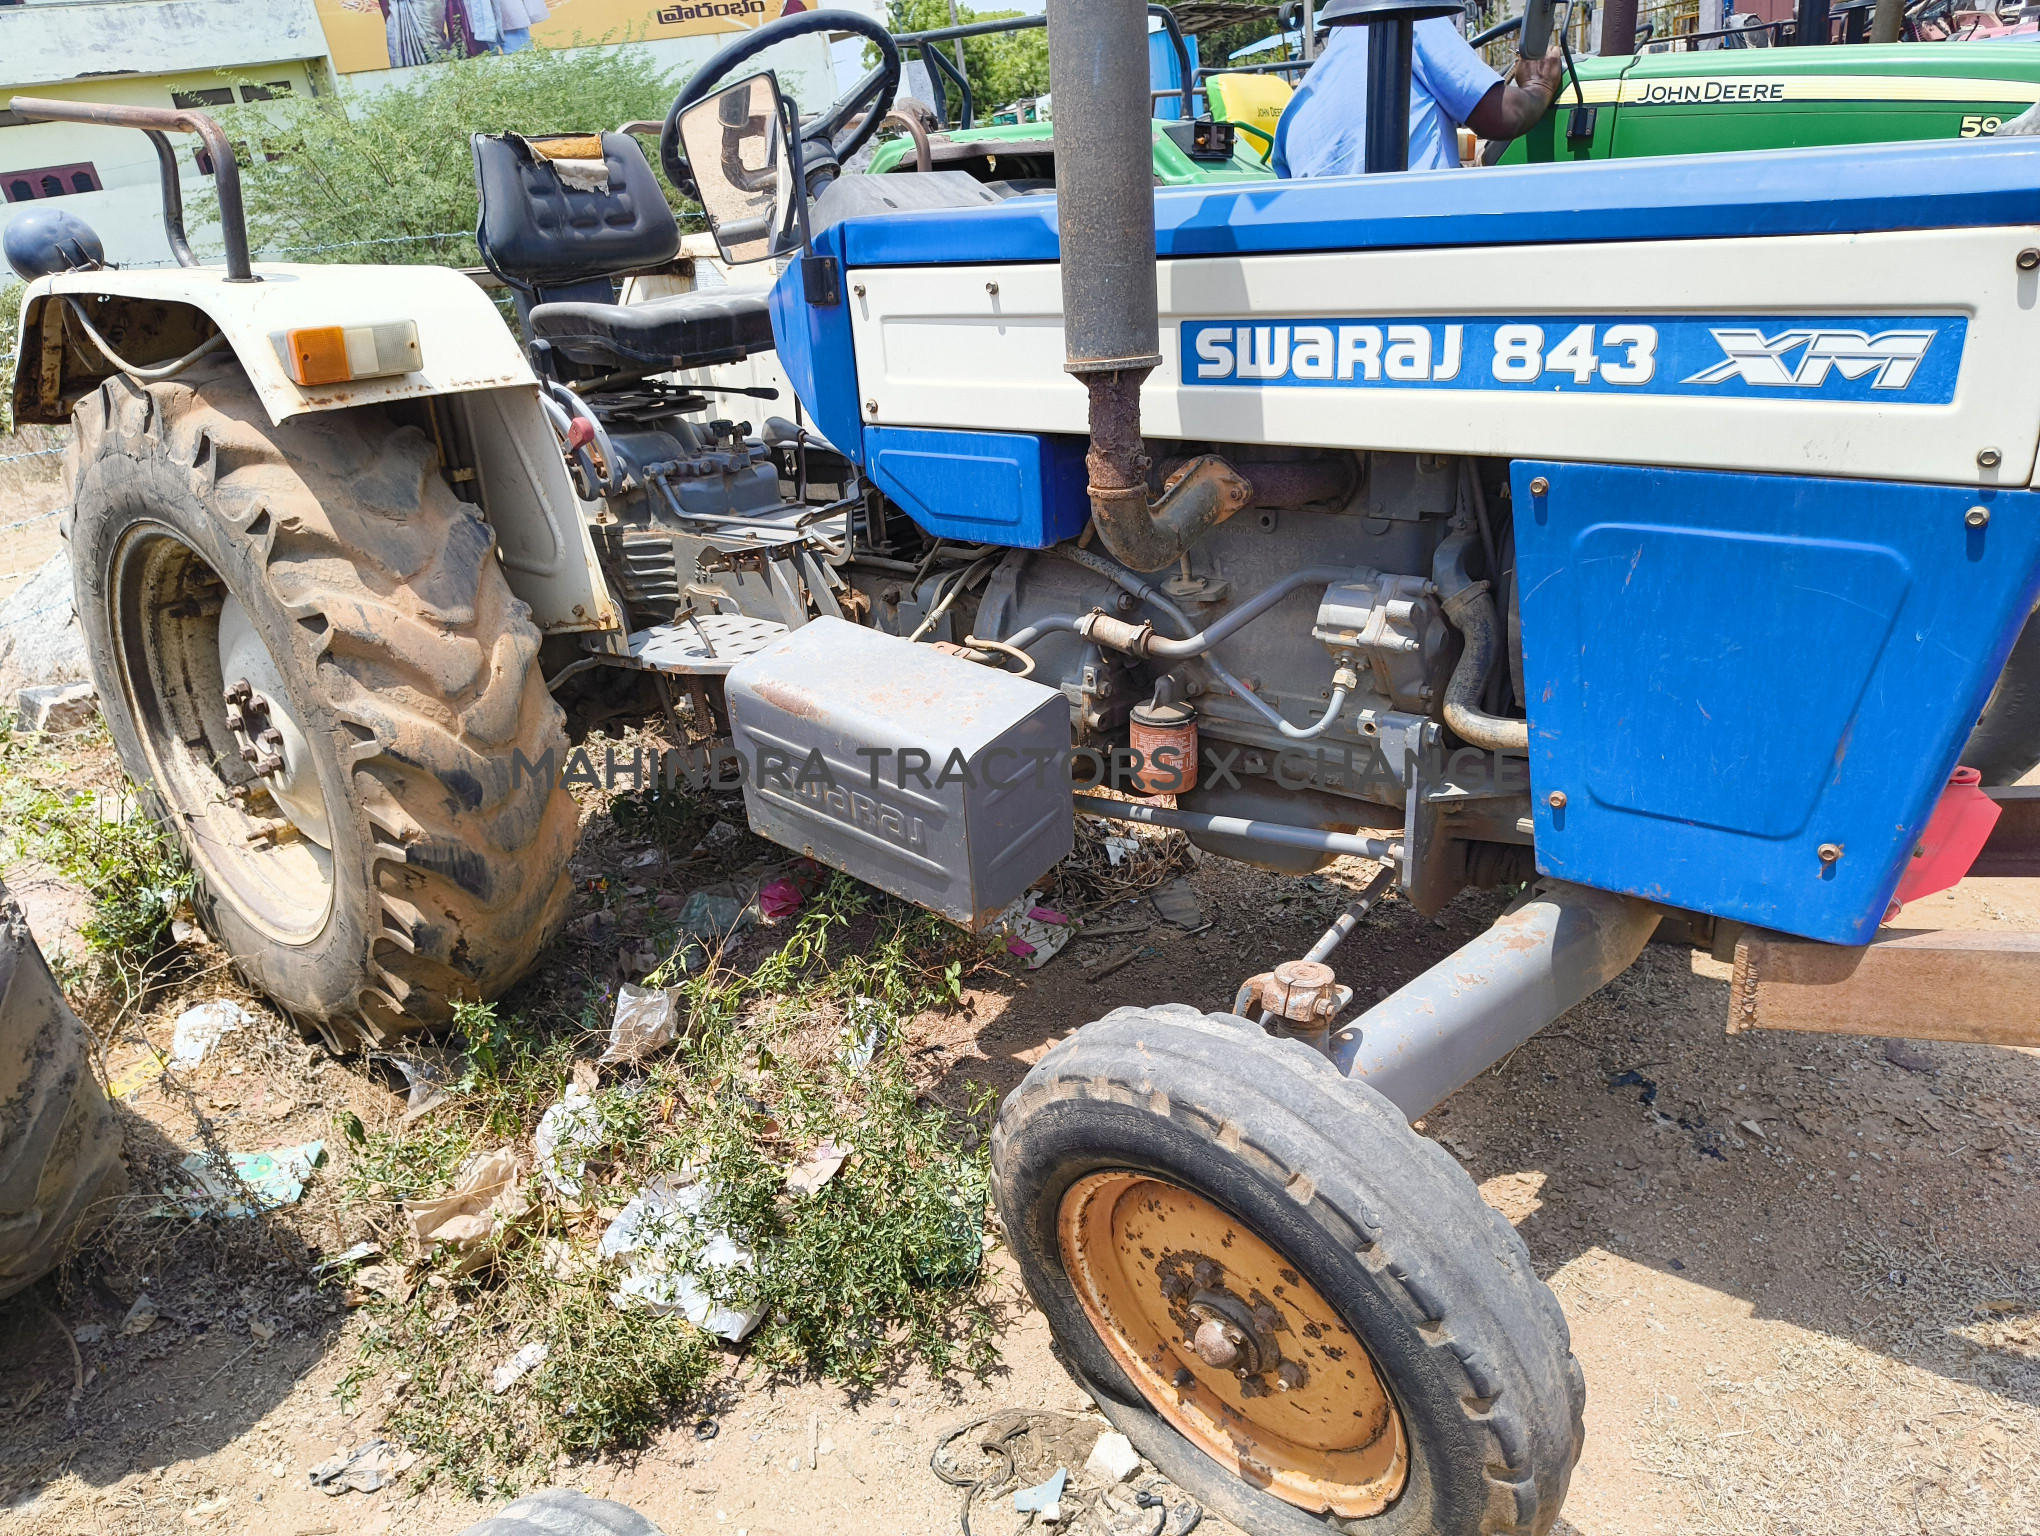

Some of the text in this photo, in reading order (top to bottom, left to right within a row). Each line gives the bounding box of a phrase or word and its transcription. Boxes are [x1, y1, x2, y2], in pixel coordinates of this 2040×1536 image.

[656, 1, 766, 25] ప్రారంభం
[1637, 81, 1785, 101] JOHN DEERE
[1491, 324, 1658, 385] 843
